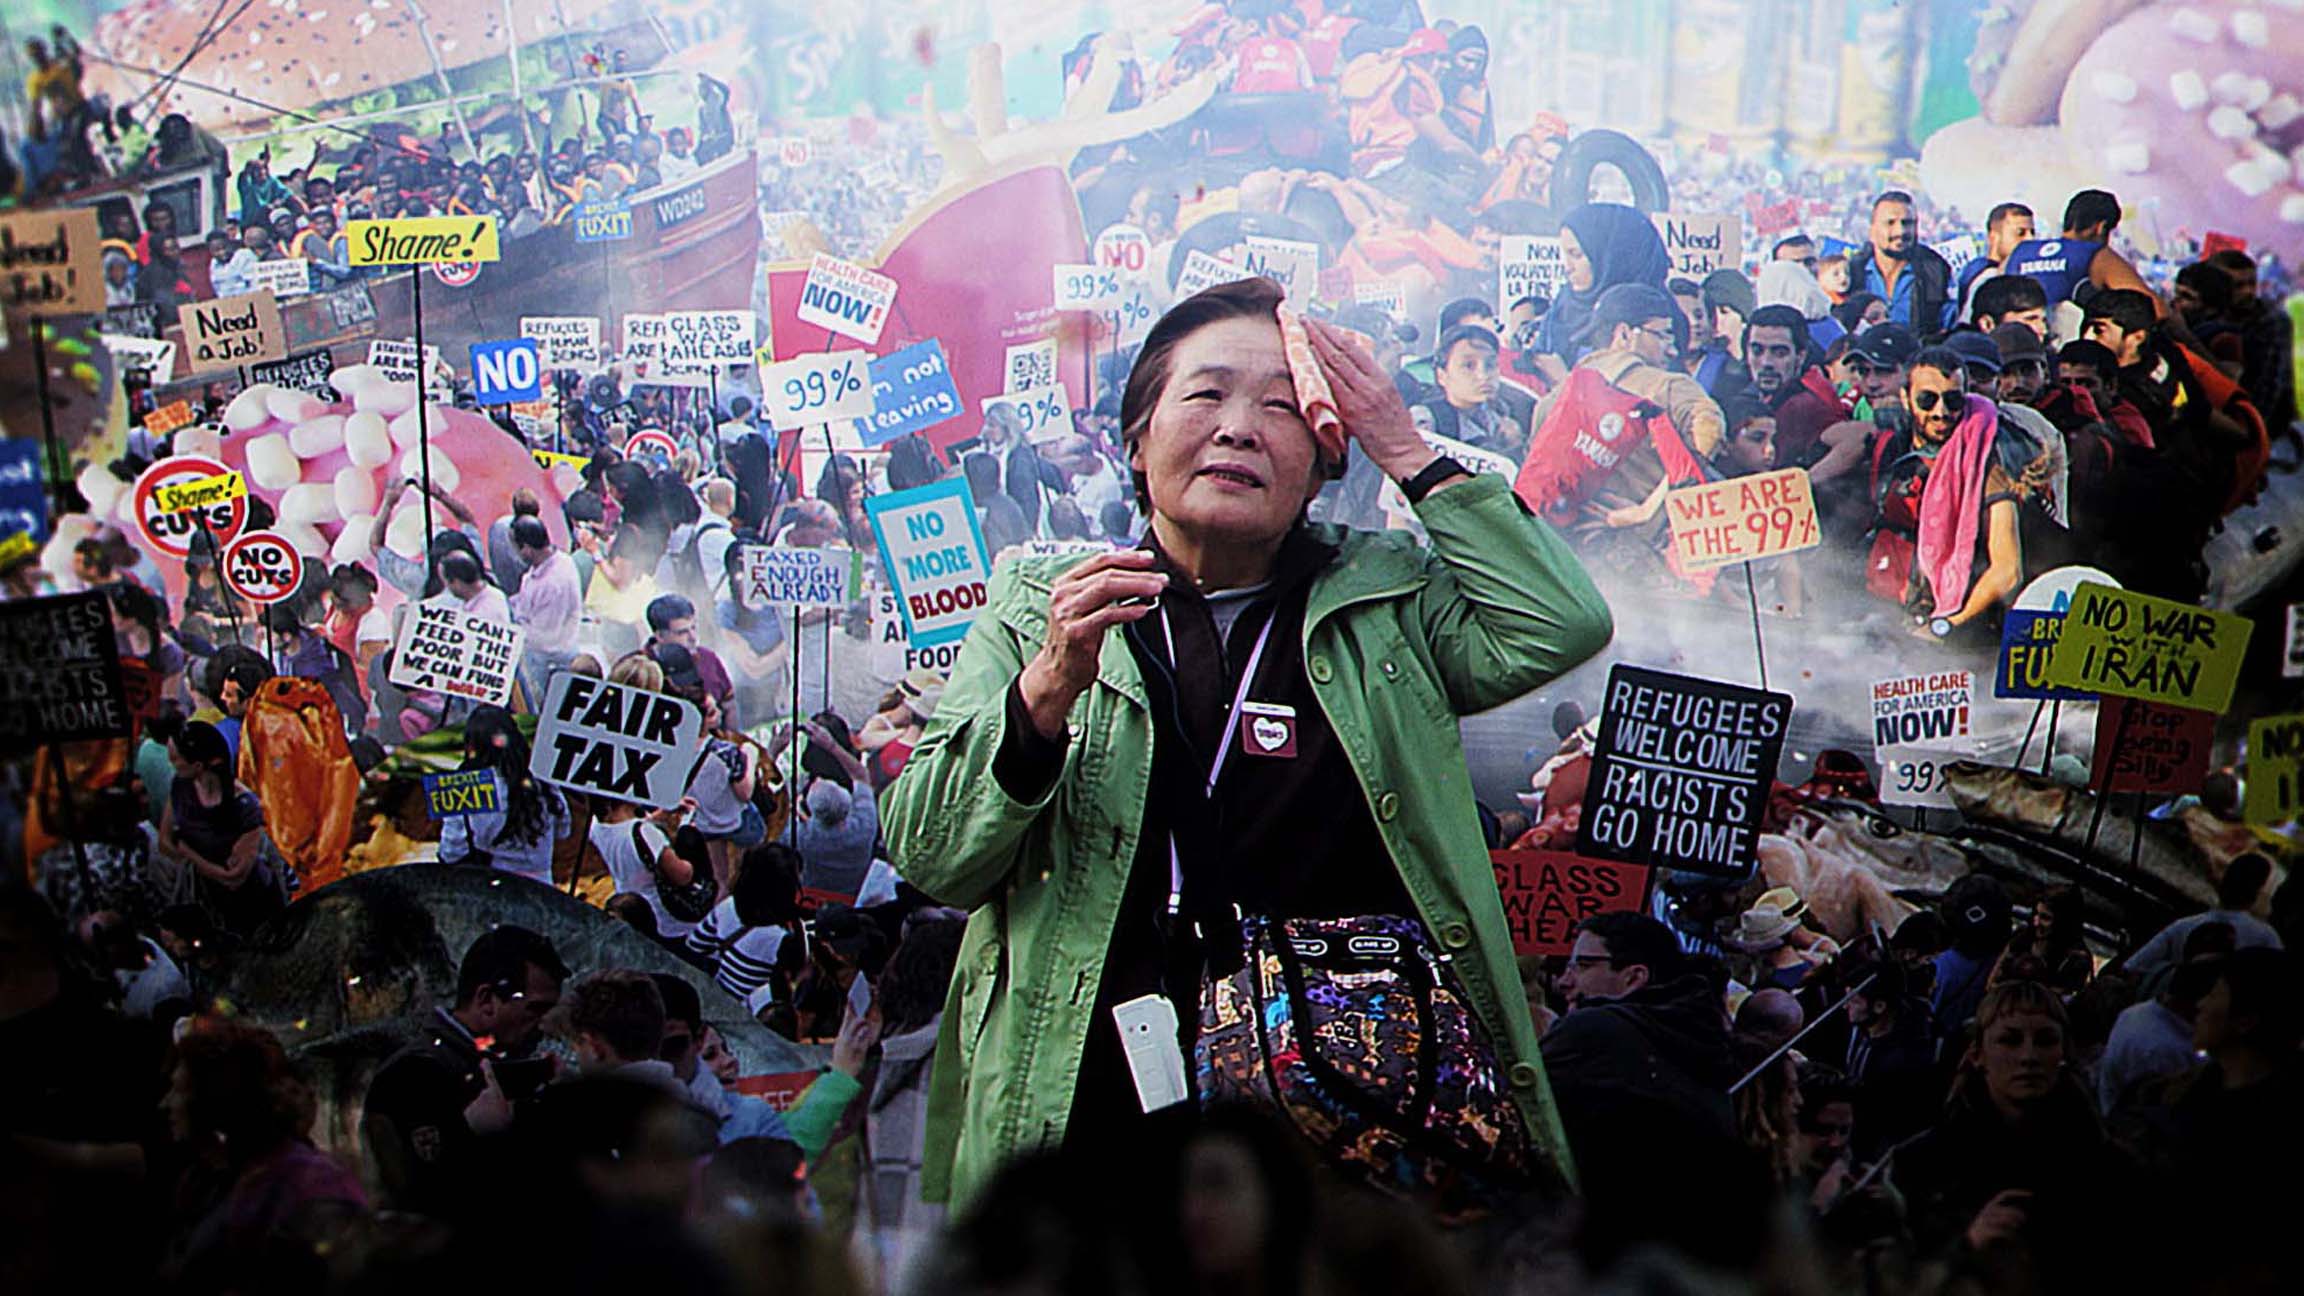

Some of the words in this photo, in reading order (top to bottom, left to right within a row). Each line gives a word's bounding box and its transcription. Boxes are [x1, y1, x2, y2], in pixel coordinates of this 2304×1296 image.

[361, 221, 487, 263] Shame!
[1666, 218, 1721, 250] Need
[1103, 240, 1146, 272] NO
[1066, 271, 1119, 299] 99%
[196, 302, 259, 339] Need
[804, 282, 883, 330] NOW!
[218, 331, 266, 360] Job!
[477, 346, 537, 394] NO
[785, 359, 862, 412] 99%
[895, 352, 942, 385] not
[862, 391, 956, 433] leaving
[166, 474, 237, 511] Shame!
[1674, 490, 1725, 520] WE
[1740, 472, 1802, 512] ARE
[147, 504, 233, 537] CUTS
[906, 510, 945, 542] NO
[1678, 522, 1742, 556] THE
[1745, 506, 1817, 553] 99%
[238, 547, 283, 566] NO
[751, 565, 839, 584] ENOUGH
[752, 550, 822, 565] TAXED
[906, 544, 972, 582] MORE
[232, 568, 292, 585] CUTS
[749, 582, 844, 604] ALREADY
[420, 604, 457, 625] WE
[908, 581, 988, 621] BLOOD
[2082, 594, 2129, 632] NO
[2143, 604, 2217, 649] WAR
[409, 637, 463, 662] POOR
[472, 653, 508, 674] BUT
[415, 621, 465, 644] FEED
[476, 635, 512, 660] THE
[402, 652, 429, 671] WE
[430, 660, 463, 679] CAN
[414, 674, 435, 687] A
[2081, 645, 2201, 697] IRAN
[1874, 677, 1926, 700] HEALTH
[1928, 671, 1969, 691] CARE
[1874, 698, 1900, 716] FOR
[1904, 689, 1970, 710] AMERICA
[556, 677, 684, 747] FAIR
[1608, 680, 1781, 738] REFUGEES
[1875, 705, 1969, 747] NOW!
[1614, 717, 1763, 775] WELCOME
[551, 732, 663, 800] TAX
[430, 783, 495, 813] FUXIT
[1602, 763, 1749, 824] RACISTS
[1592, 804, 1639, 849] GO
[1652, 814, 1750, 868] HOME
[1502, 893, 1603, 919] WAR
